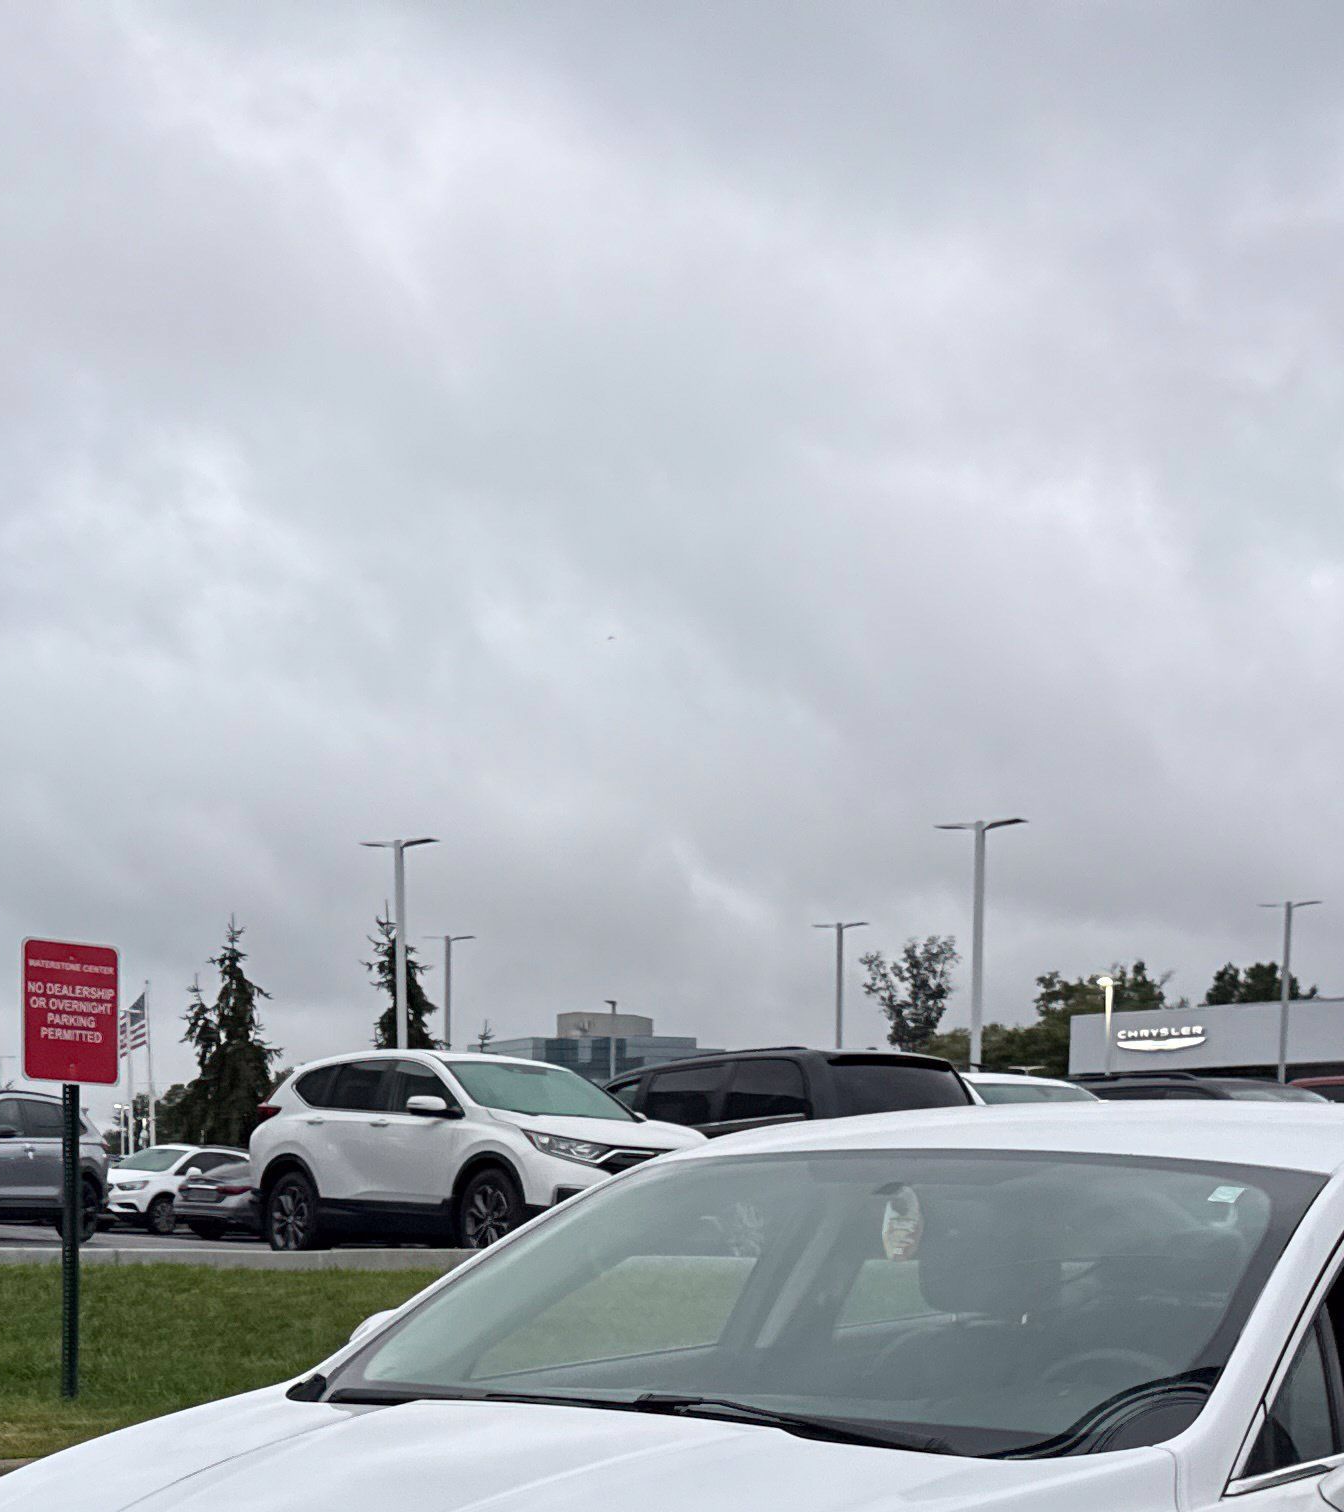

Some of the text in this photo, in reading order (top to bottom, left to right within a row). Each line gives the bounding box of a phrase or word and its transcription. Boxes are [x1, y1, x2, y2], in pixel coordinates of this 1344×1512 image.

[27, 981, 115, 1000] NO DEALERSHIP
[29, 996, 112, 1015] OR OVERNIGHT
[47, 1012, 96, 1028] PARKING
[40, 1026, 103, 1043] PERMITTED
[1117, 1025, 1203, 1039] CHRYSLER
